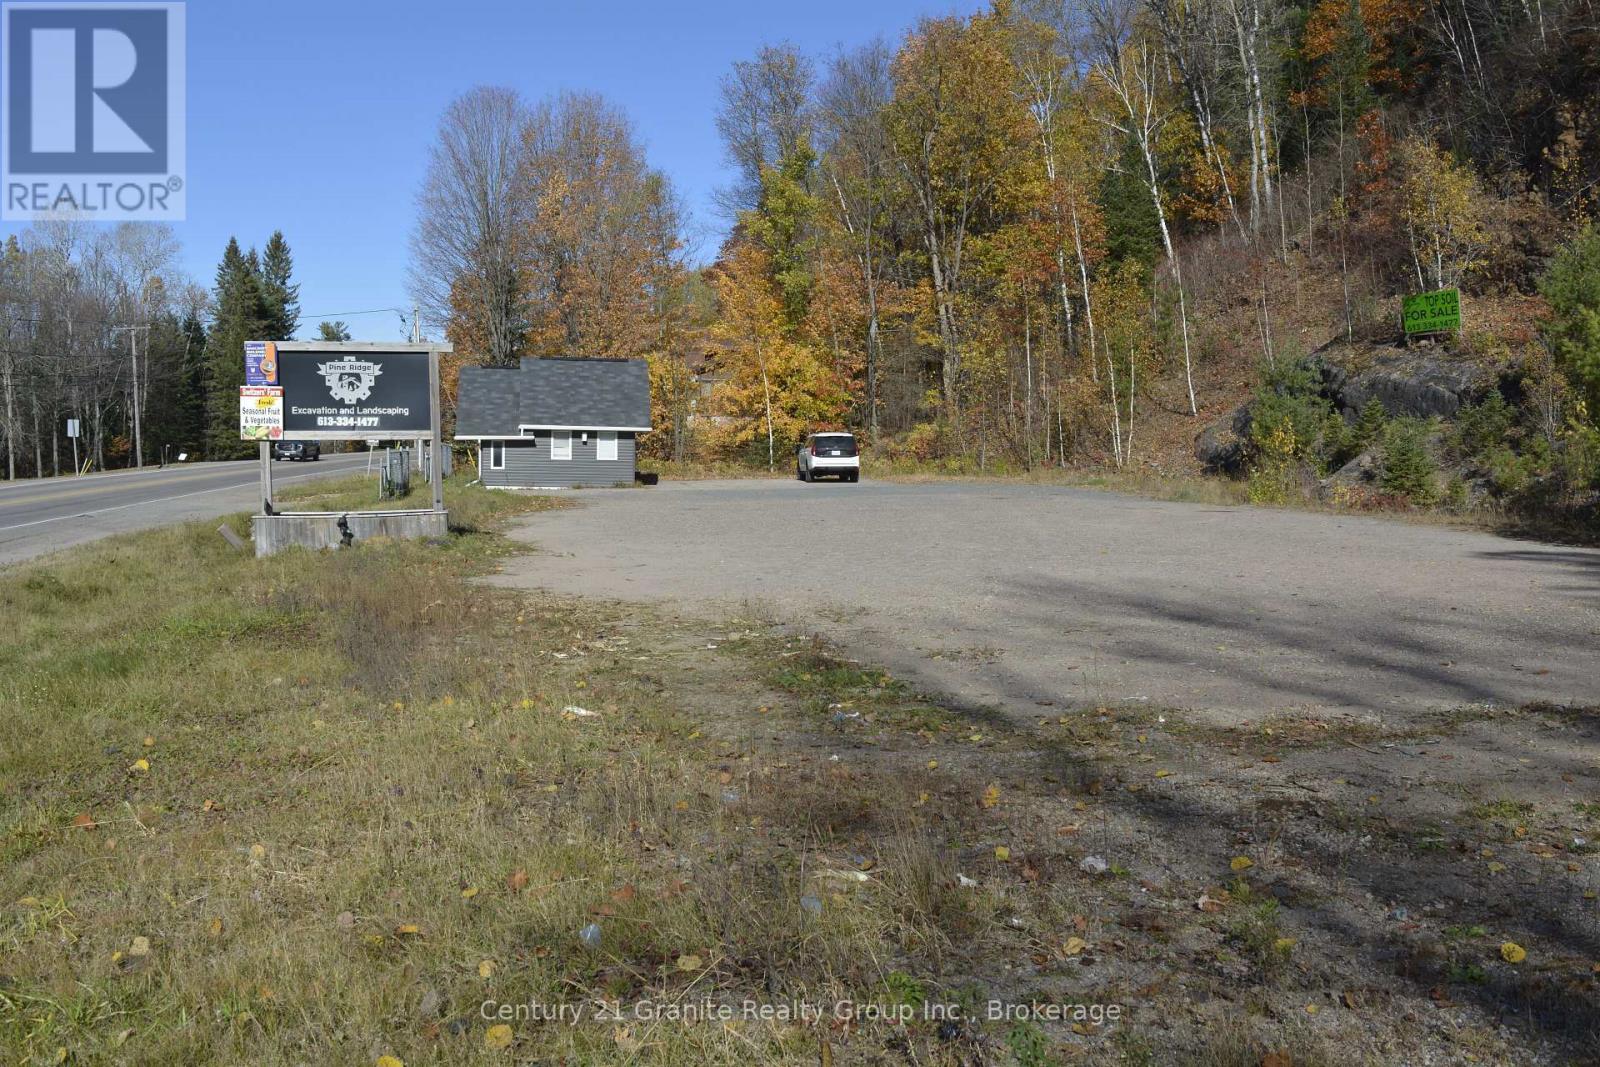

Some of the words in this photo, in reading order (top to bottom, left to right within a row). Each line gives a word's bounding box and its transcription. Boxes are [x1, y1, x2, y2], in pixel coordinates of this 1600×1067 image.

[1424, 294, 1439, 307] TOP
[1442, 292, 1458, 305] SOIL
[1405, 309, 1427, 321] FOR
[1430, 305, 1458, 318] SALE
[242, 407, 266, 415] Seasonal
[267, 407, 280, 415] Fruit
[291, 406, 338, 415] Excavation
[340, 406, 355, 415] and
[357, 406, 409, 417] Landscaping
[244, 416, 249, 424] &
[250, 416, 280, 425] Vegetables
[317, 417, 379, 427] 613-334-1477
